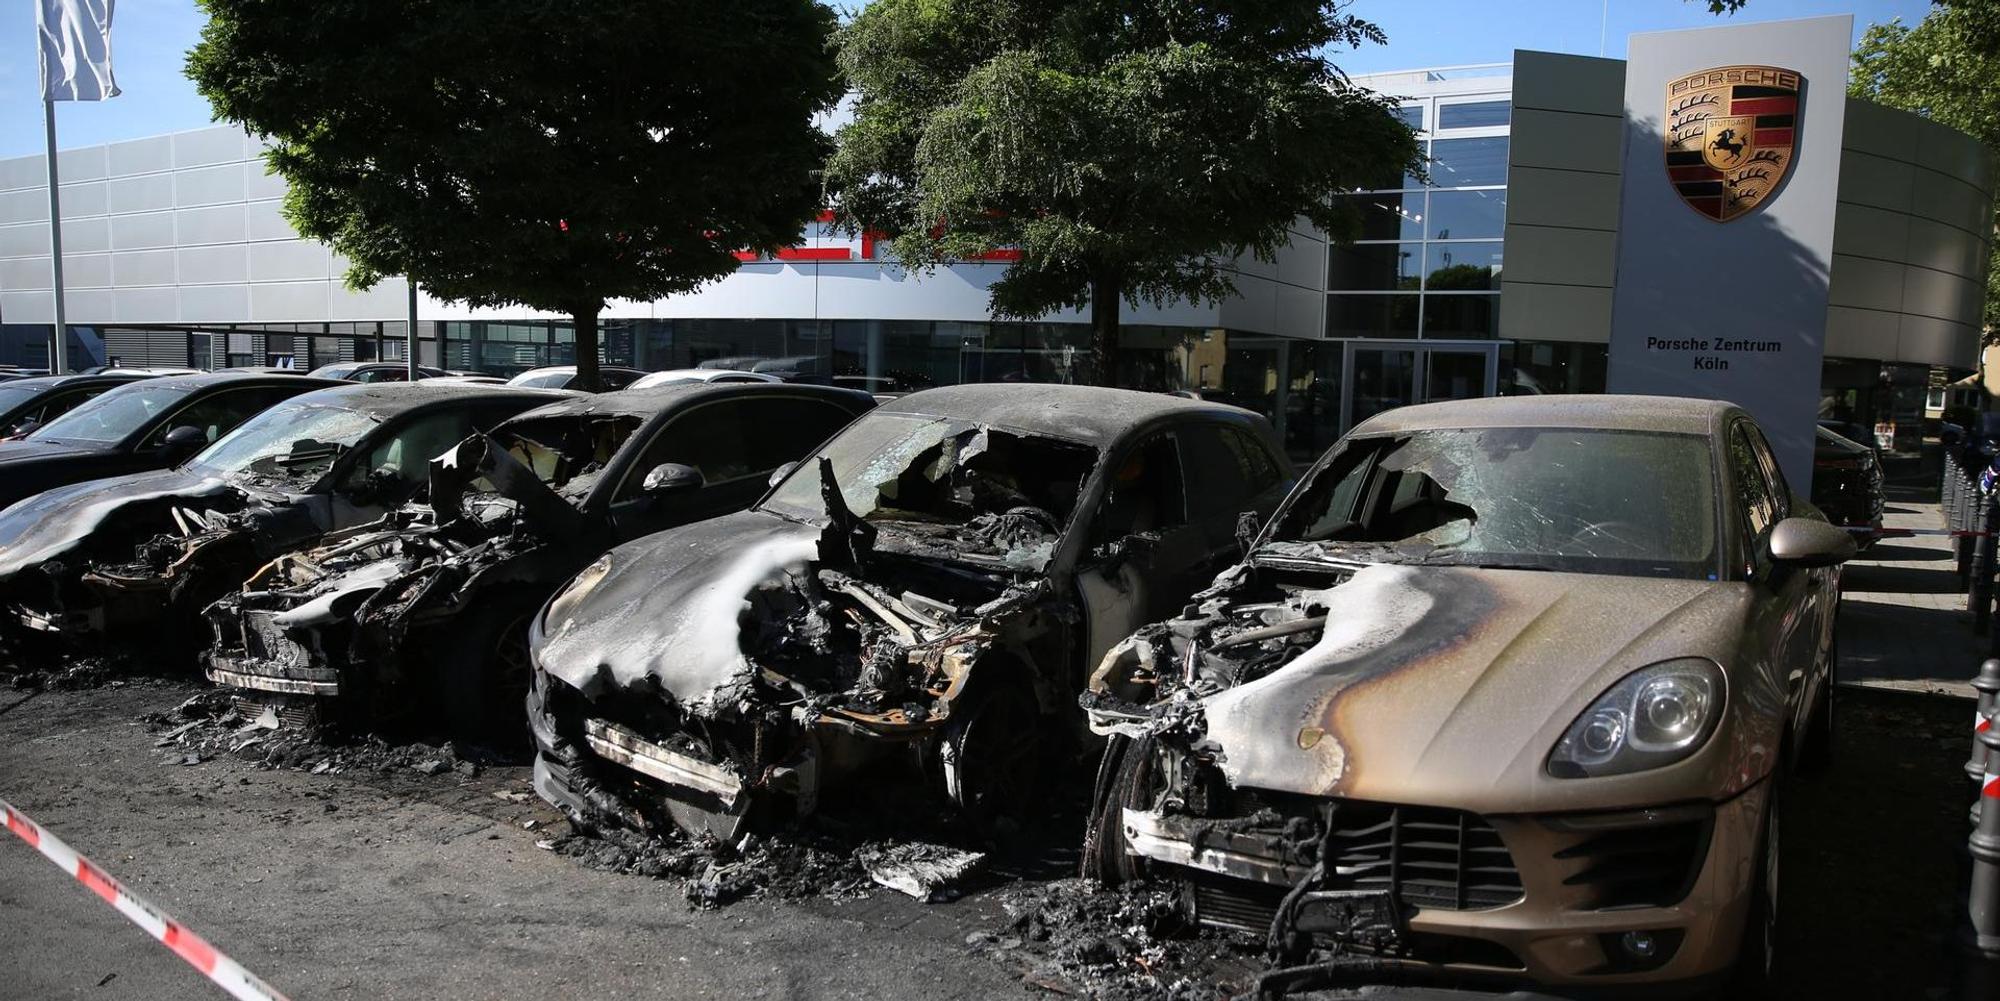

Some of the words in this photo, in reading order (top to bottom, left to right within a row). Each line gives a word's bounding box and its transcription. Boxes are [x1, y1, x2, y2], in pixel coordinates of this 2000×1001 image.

[1671, 70, 1798, 95] PORSCHE
[1709, 119, 1750, 128] STUTTGART
[1647, 336, 1708, 351] Porsche
[1714, 337, 1781, 352] Zentrum
[1693, 356, 1729, 370] Köln
